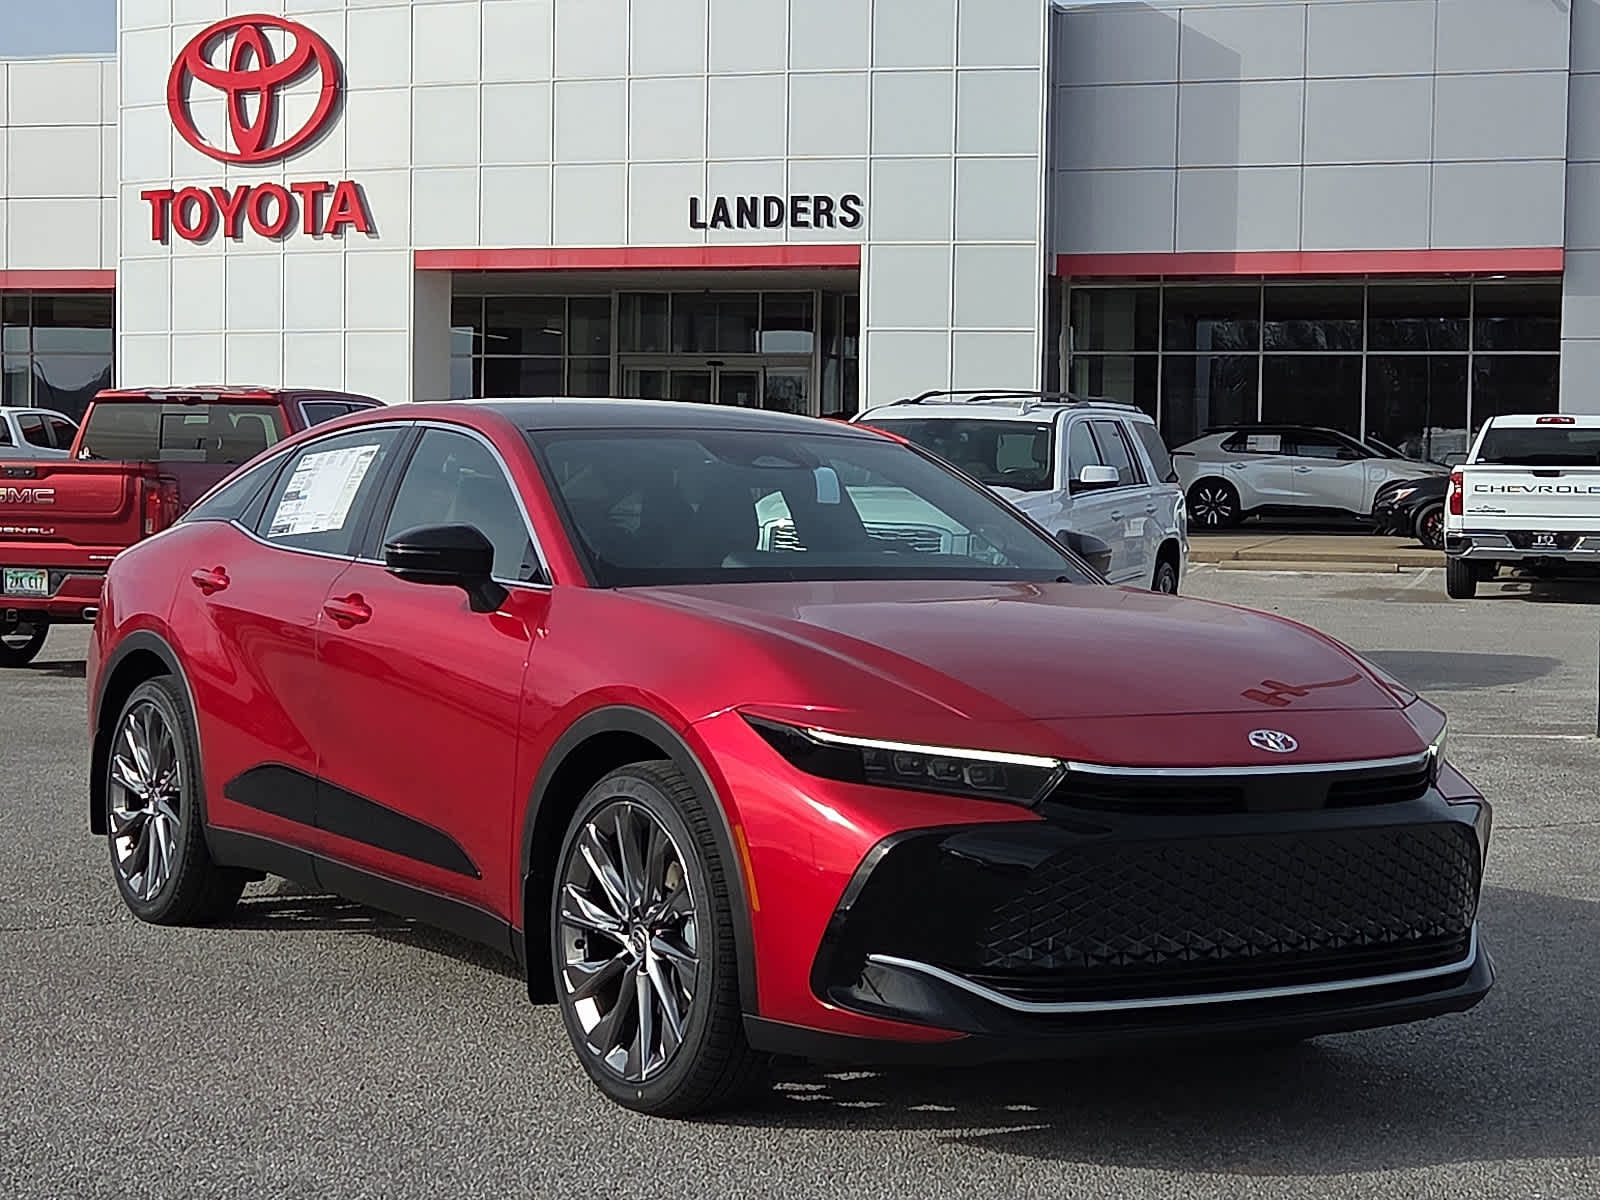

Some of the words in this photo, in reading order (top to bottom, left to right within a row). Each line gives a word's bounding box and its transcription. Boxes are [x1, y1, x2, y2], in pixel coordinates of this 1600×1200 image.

[141, 180, 374, 243] TOYOTA
[689, 195, 862, 229] LANDERS
[0, 487, 55, 503] MC
[0, 527, 55, 535] ENALI
